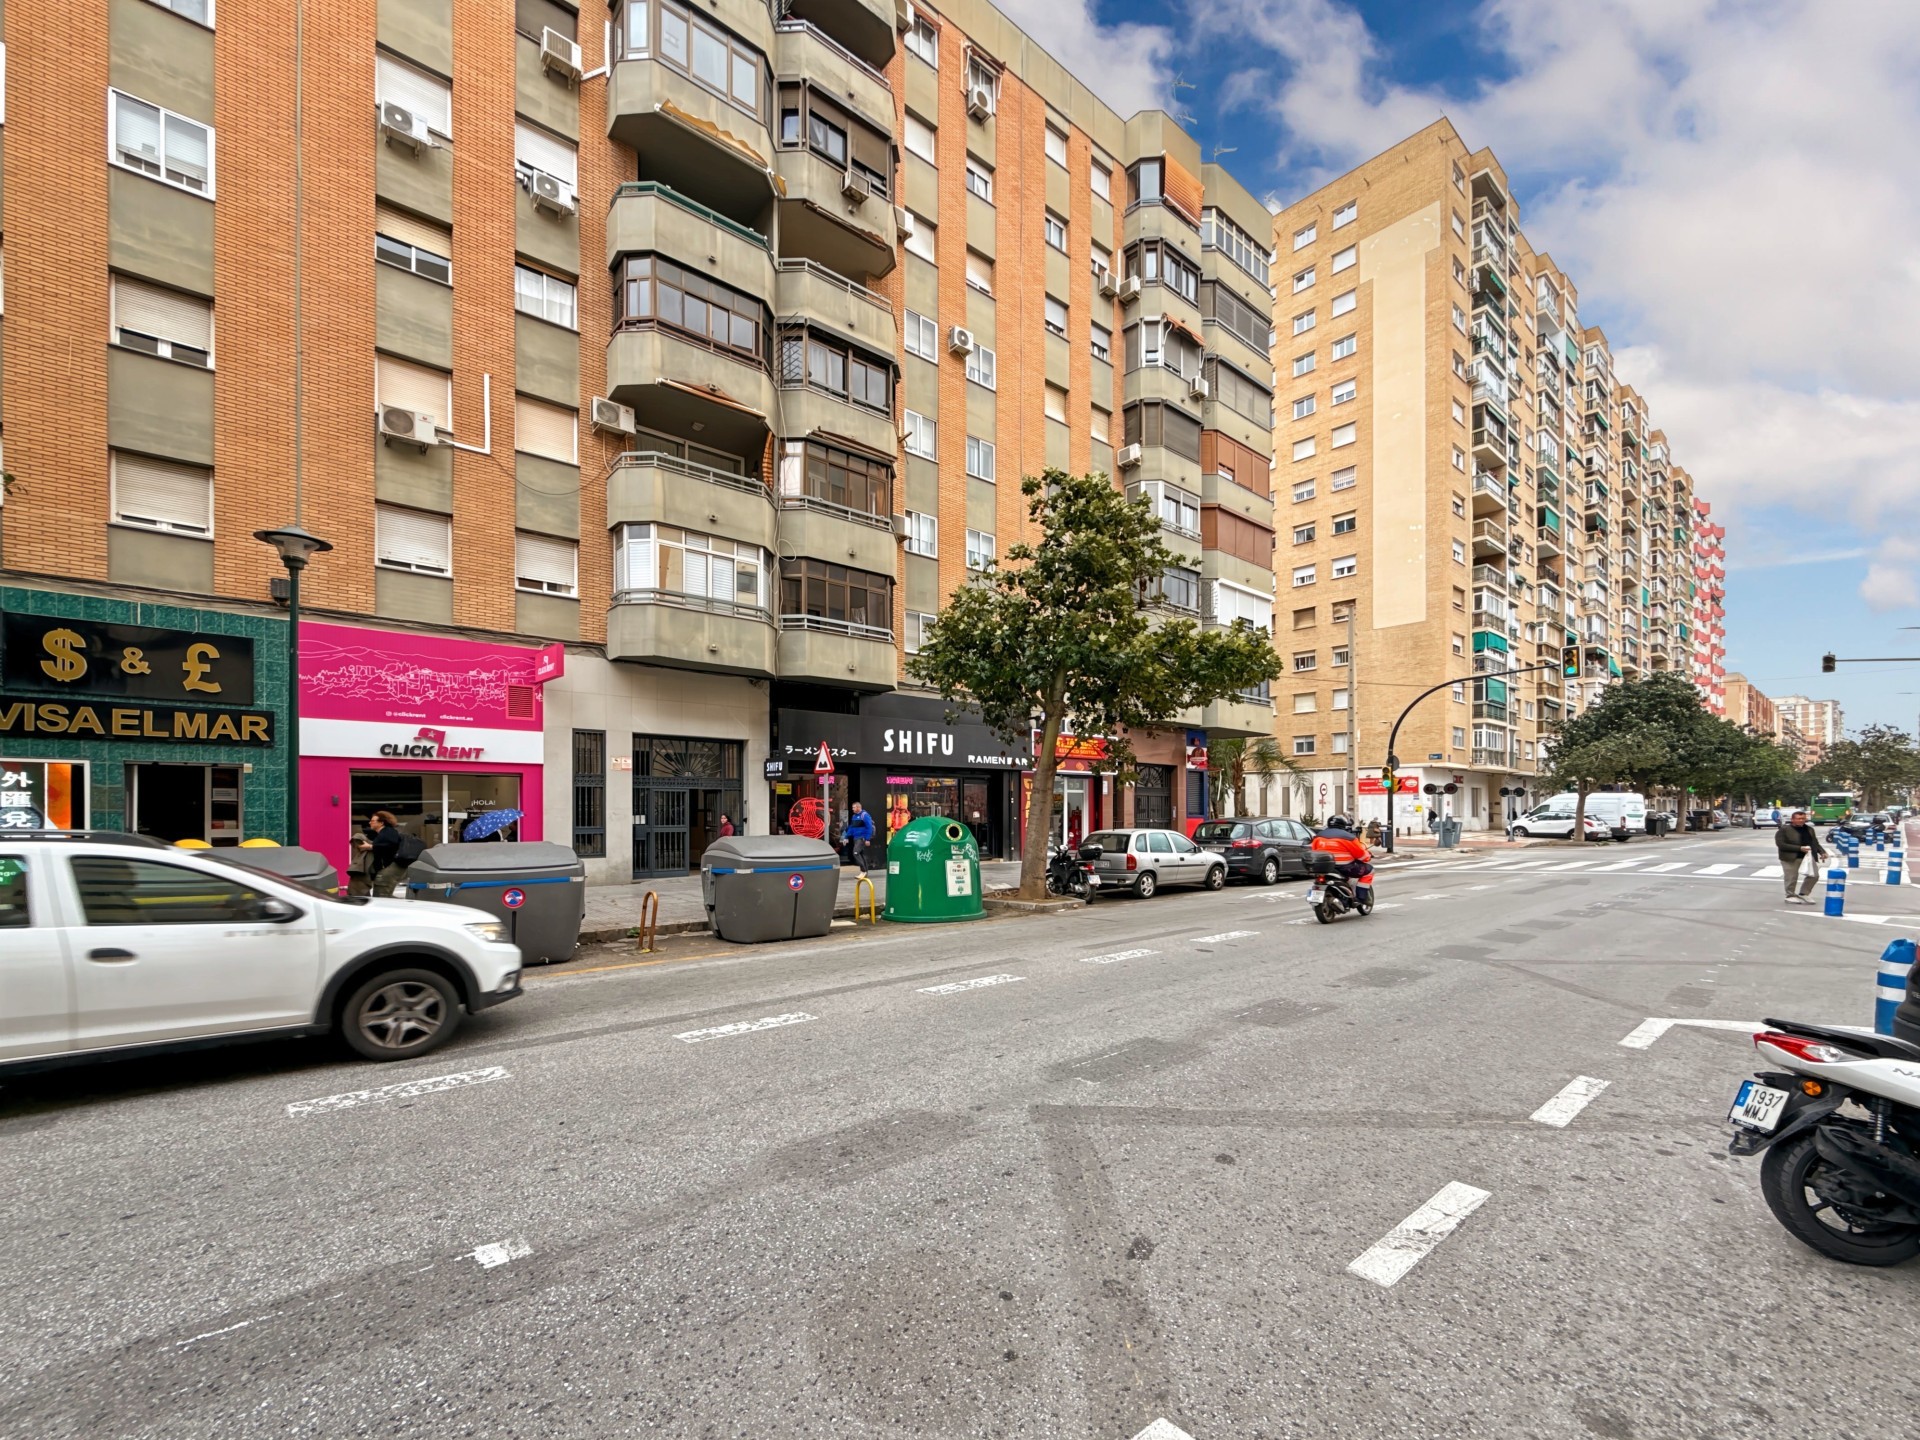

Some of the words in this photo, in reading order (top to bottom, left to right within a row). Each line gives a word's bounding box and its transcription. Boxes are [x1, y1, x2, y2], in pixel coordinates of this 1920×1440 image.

[41, 628, 87, 682] $
[121, 647, 151, 675] &
[182, 643, 222, 693] £
[0, 703, 105, 735] VISA
[785, 745, 857, 757] ラーメンスター
[883, 729, 954, 755] SHIFU
[766, 761, 783, 772] SHIFU
[1752, 1089, 1783, 1108] 1937
[1743, 1103, 1769, 1121] MMJ
